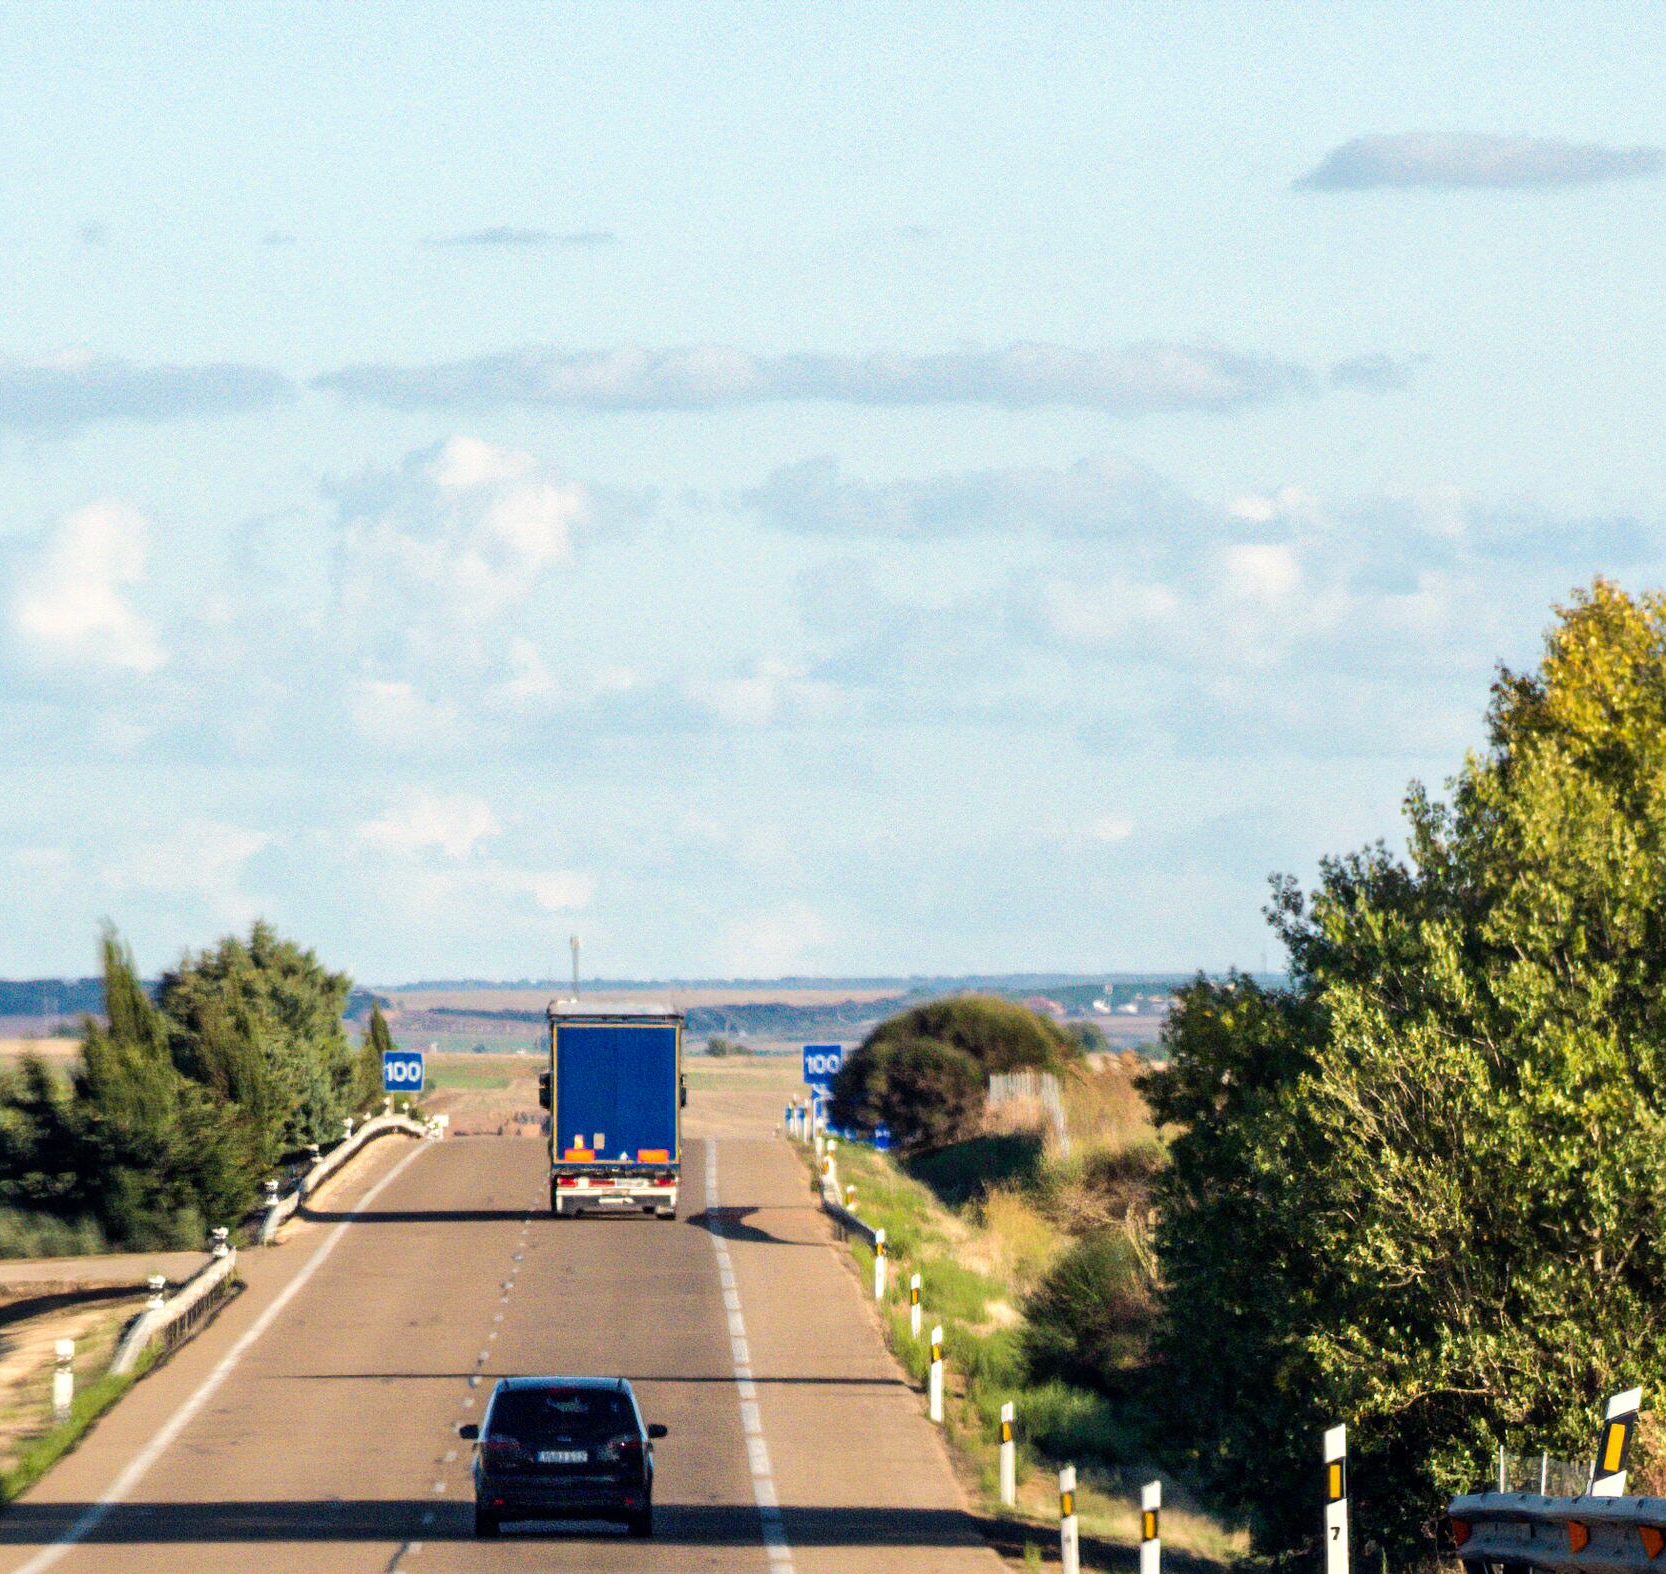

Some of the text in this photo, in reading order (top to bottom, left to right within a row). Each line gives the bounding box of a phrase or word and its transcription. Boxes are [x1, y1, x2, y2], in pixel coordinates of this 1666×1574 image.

[385, 1061, 421, 1083] 100
[805, 1054, 840, 1075] 100
[1330, 1526, 1341, 1541] 7
